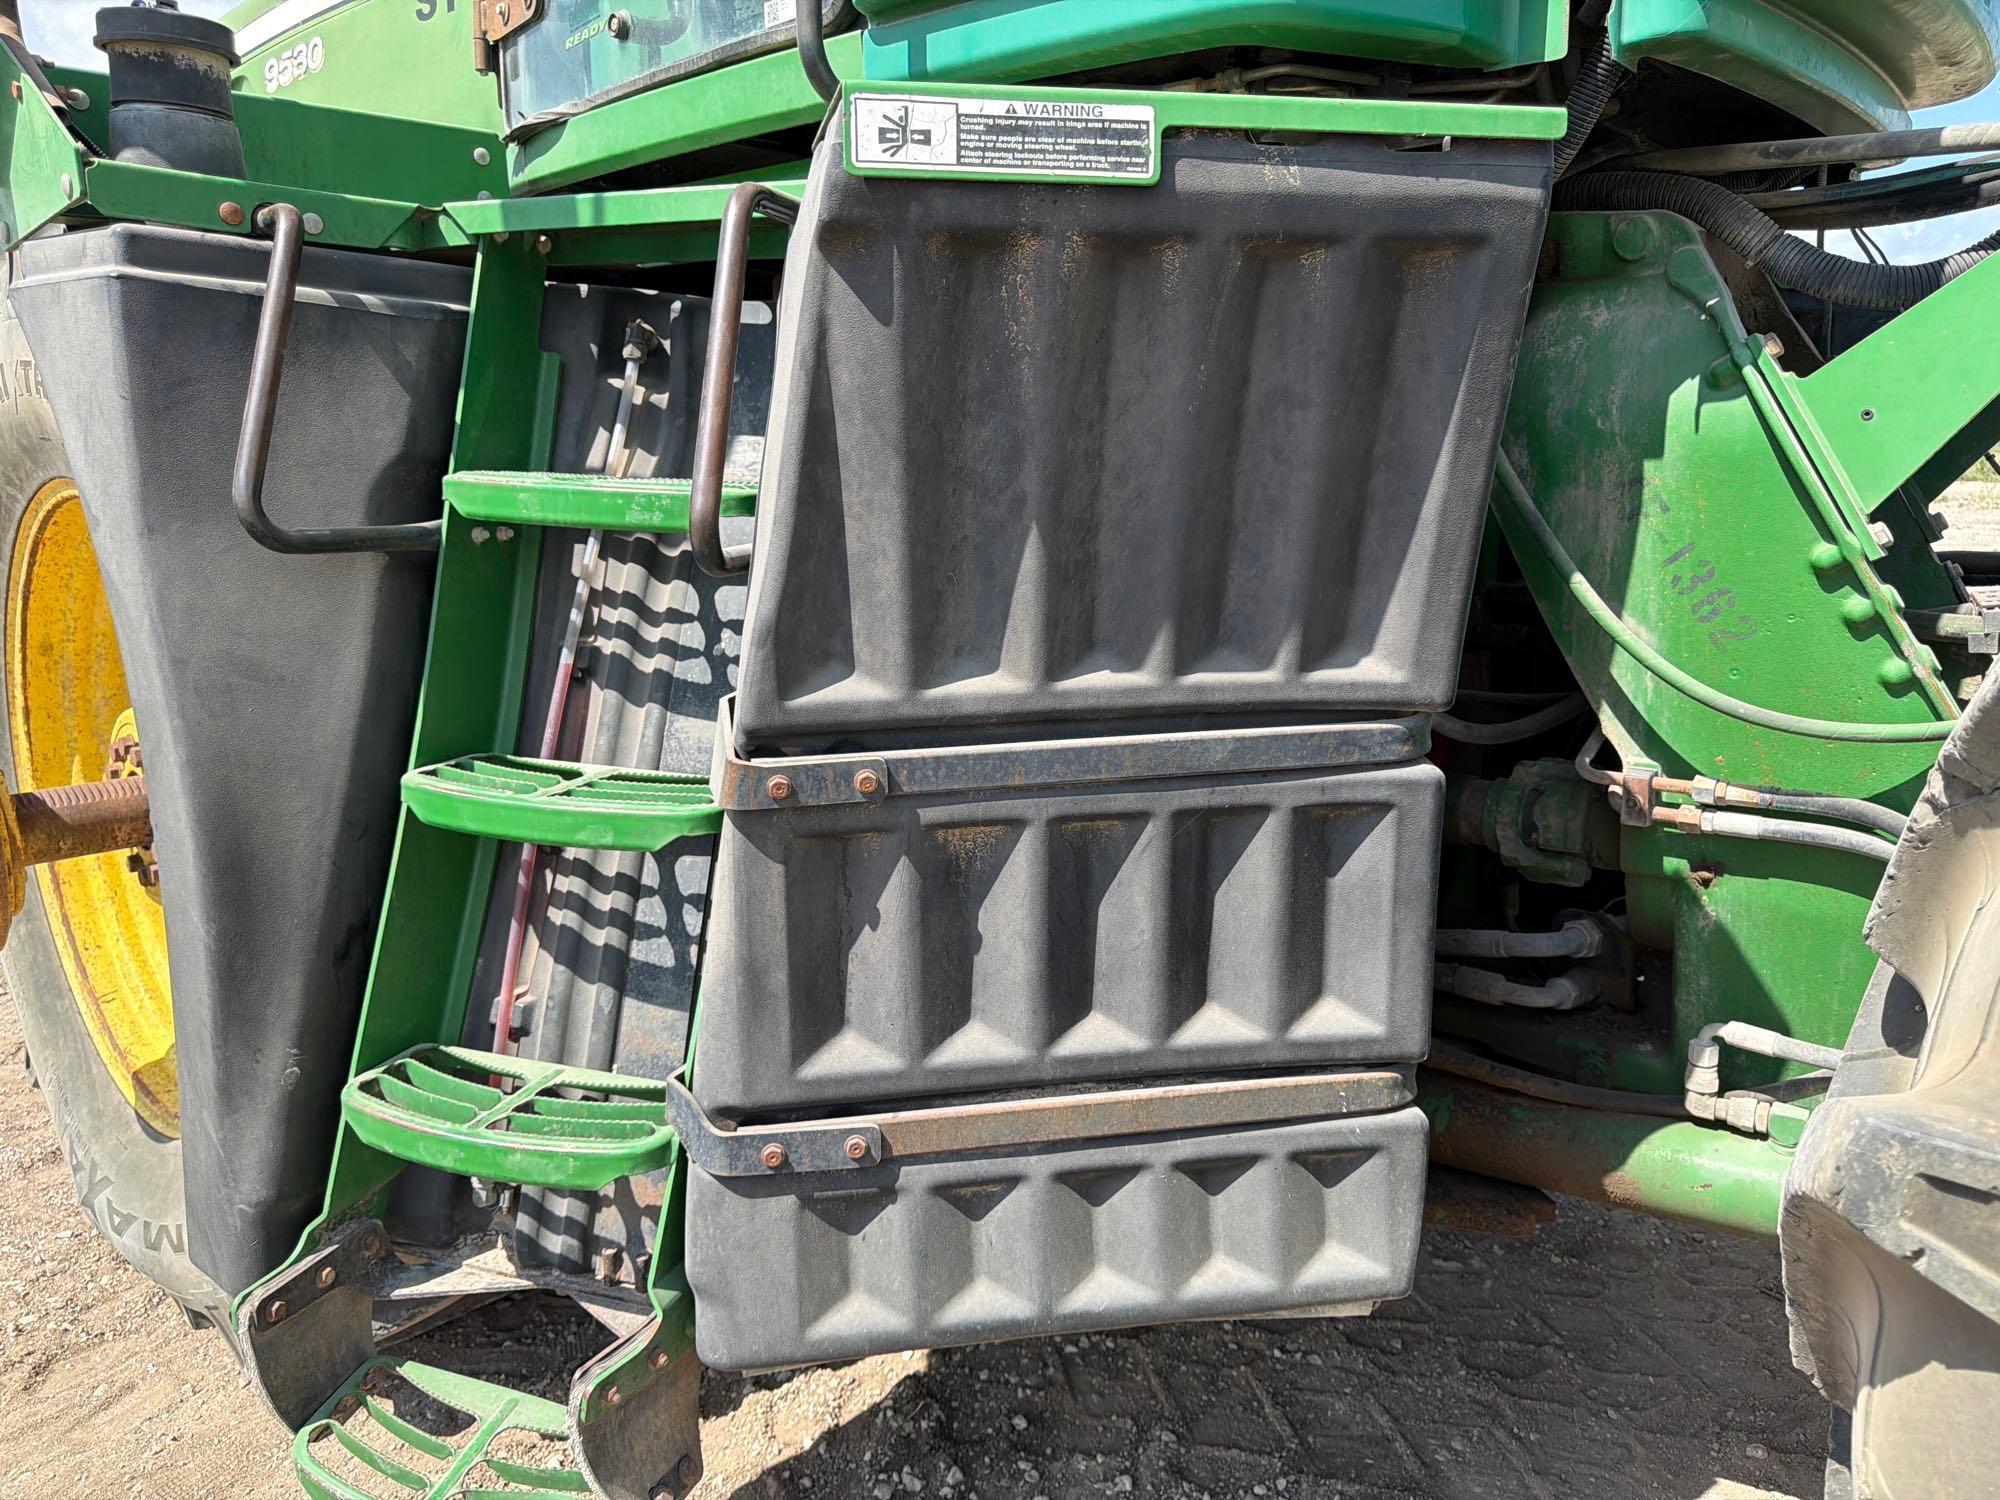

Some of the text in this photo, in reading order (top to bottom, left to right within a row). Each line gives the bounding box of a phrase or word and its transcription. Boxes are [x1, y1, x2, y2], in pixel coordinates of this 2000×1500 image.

[565, 17, 608, 50] READY
[264, 36, 324, 94] 9530
[1024, 103, 1103, 117] WARNING
[960, 116, 993, 125] Crushing
[1066, 120, 1086, 129] hinge
[1111, 121, 1139, 129] machine
[996, 142, 1022, 150] moving
[1024, 143, 1053, 151] steering
[1066, 137, 1095, 145] machine
[1097, 138, 1118, 146] before
[985, 151, 1012, 159] steering
[1068, 154, 1105, 163] performing
[1107, 155, 1130, 163] service
[1032, 160, 1074, 168] transporting
[1661, 541, 1758, 652] 1362
